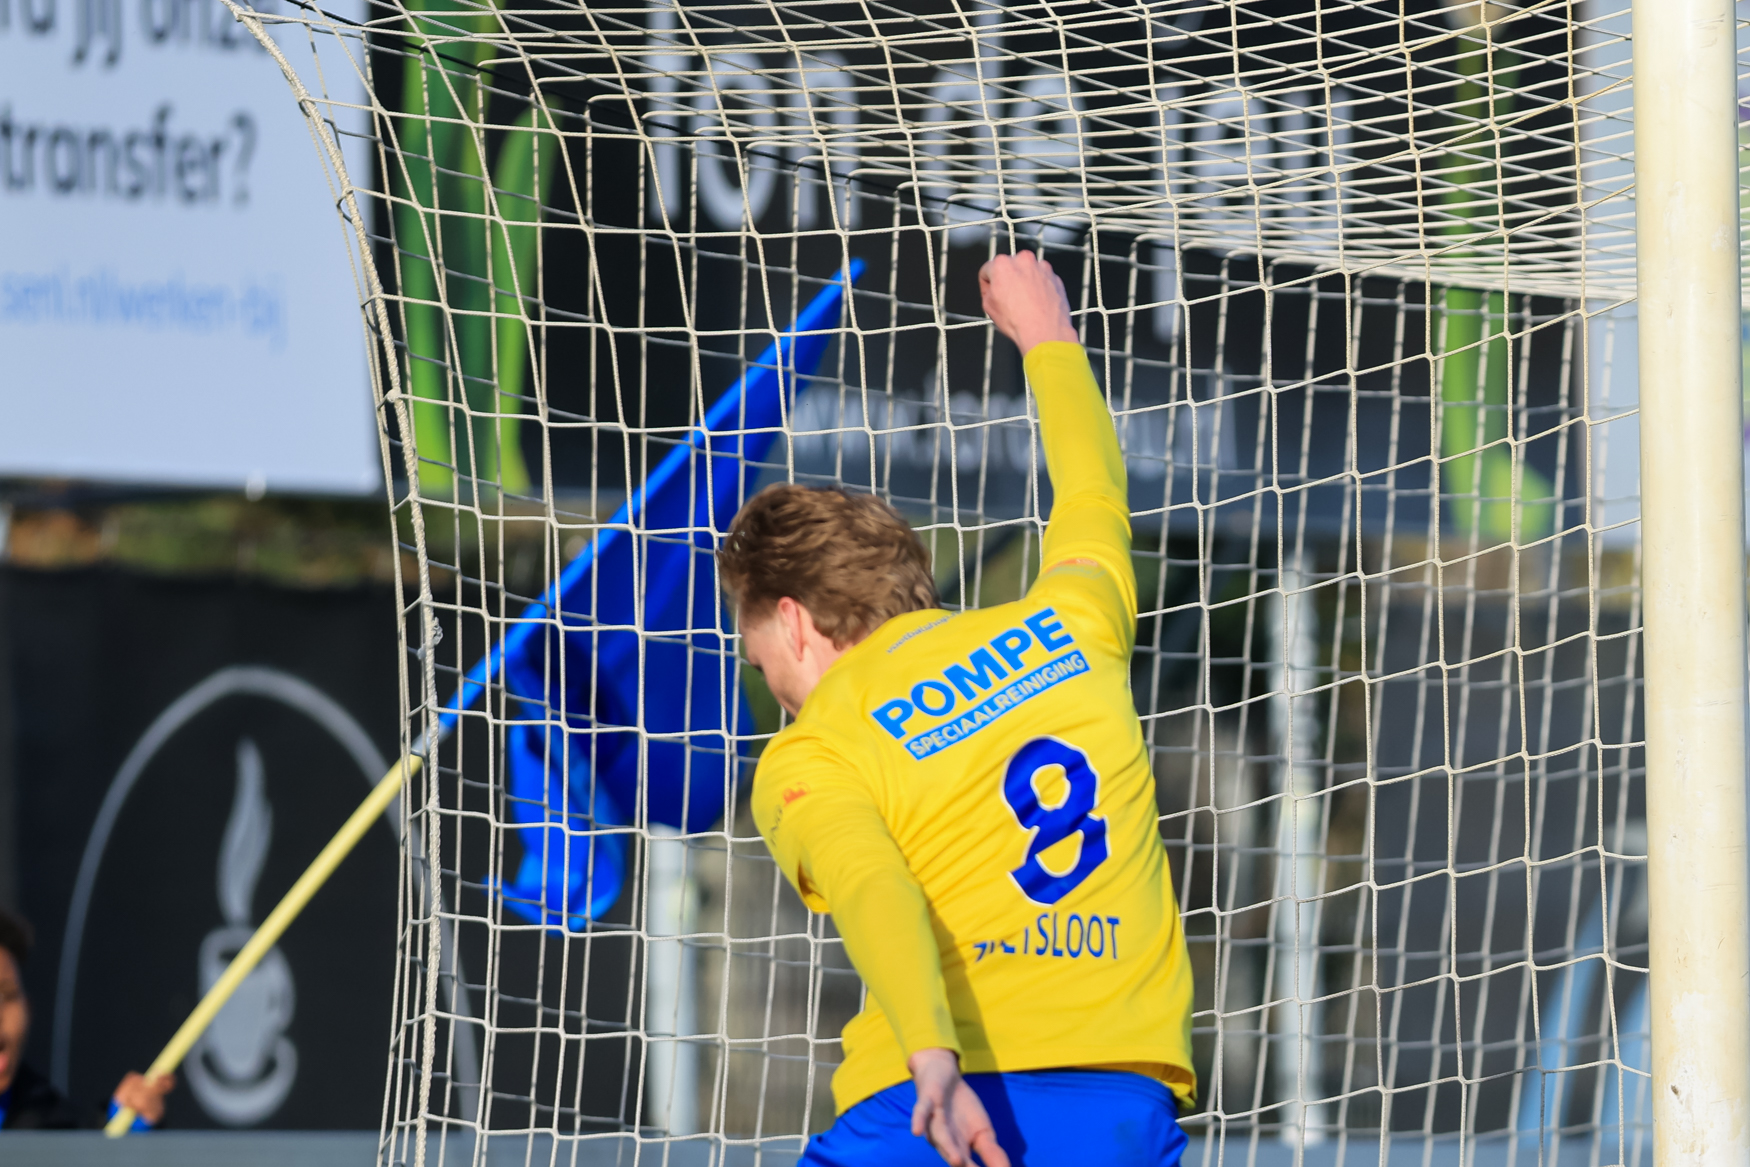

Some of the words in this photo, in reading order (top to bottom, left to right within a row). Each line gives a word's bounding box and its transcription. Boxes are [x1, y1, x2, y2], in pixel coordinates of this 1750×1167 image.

[870, 606, 1075, 741] POMPE
[909, 653, 1086, 757] SPECIAALREINIGING
[1001, 734, 1111, 906] 8
